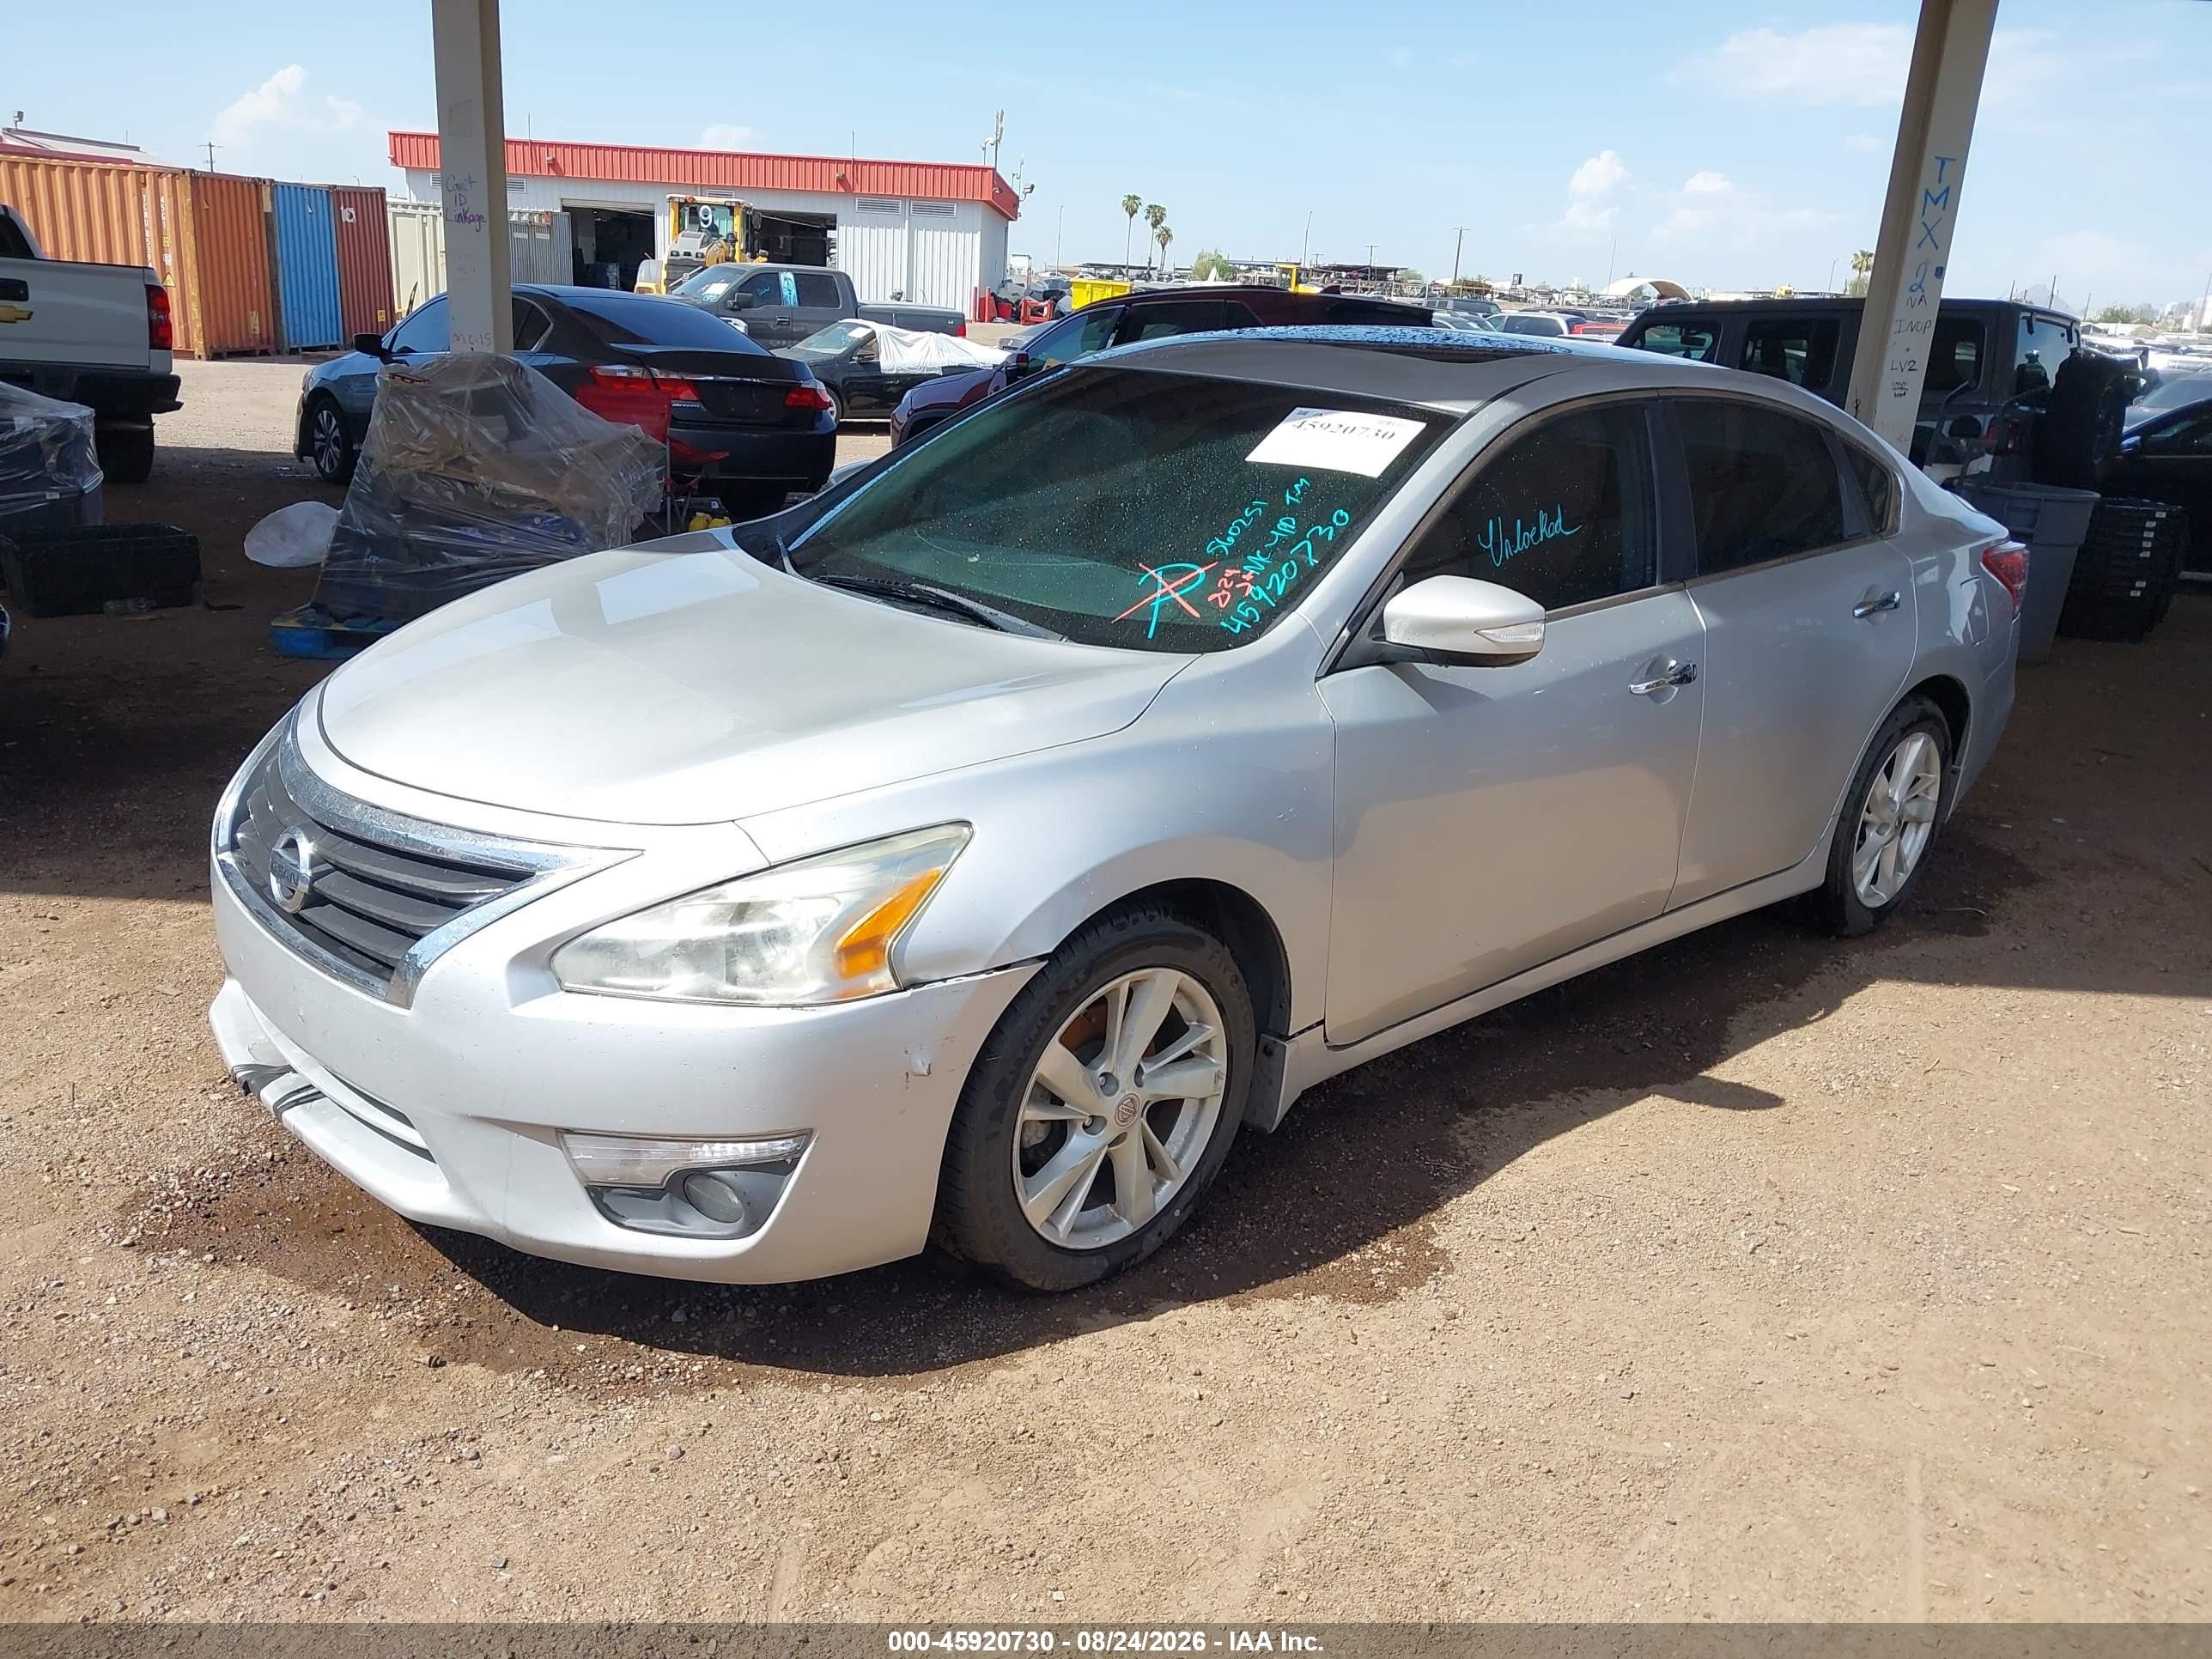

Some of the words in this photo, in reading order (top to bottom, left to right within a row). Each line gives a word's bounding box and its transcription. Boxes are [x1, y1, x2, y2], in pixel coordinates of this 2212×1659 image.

[454, 193, 468, 207] ID
[699, 204, 713, 228] 9
[1893, 319, 1933, 336] INOP
[1890, 359, 1918, 373] LV2
[1477, 503, 1583, 568] Unlocked
[1219, 508, 1350, 634] 45920730
